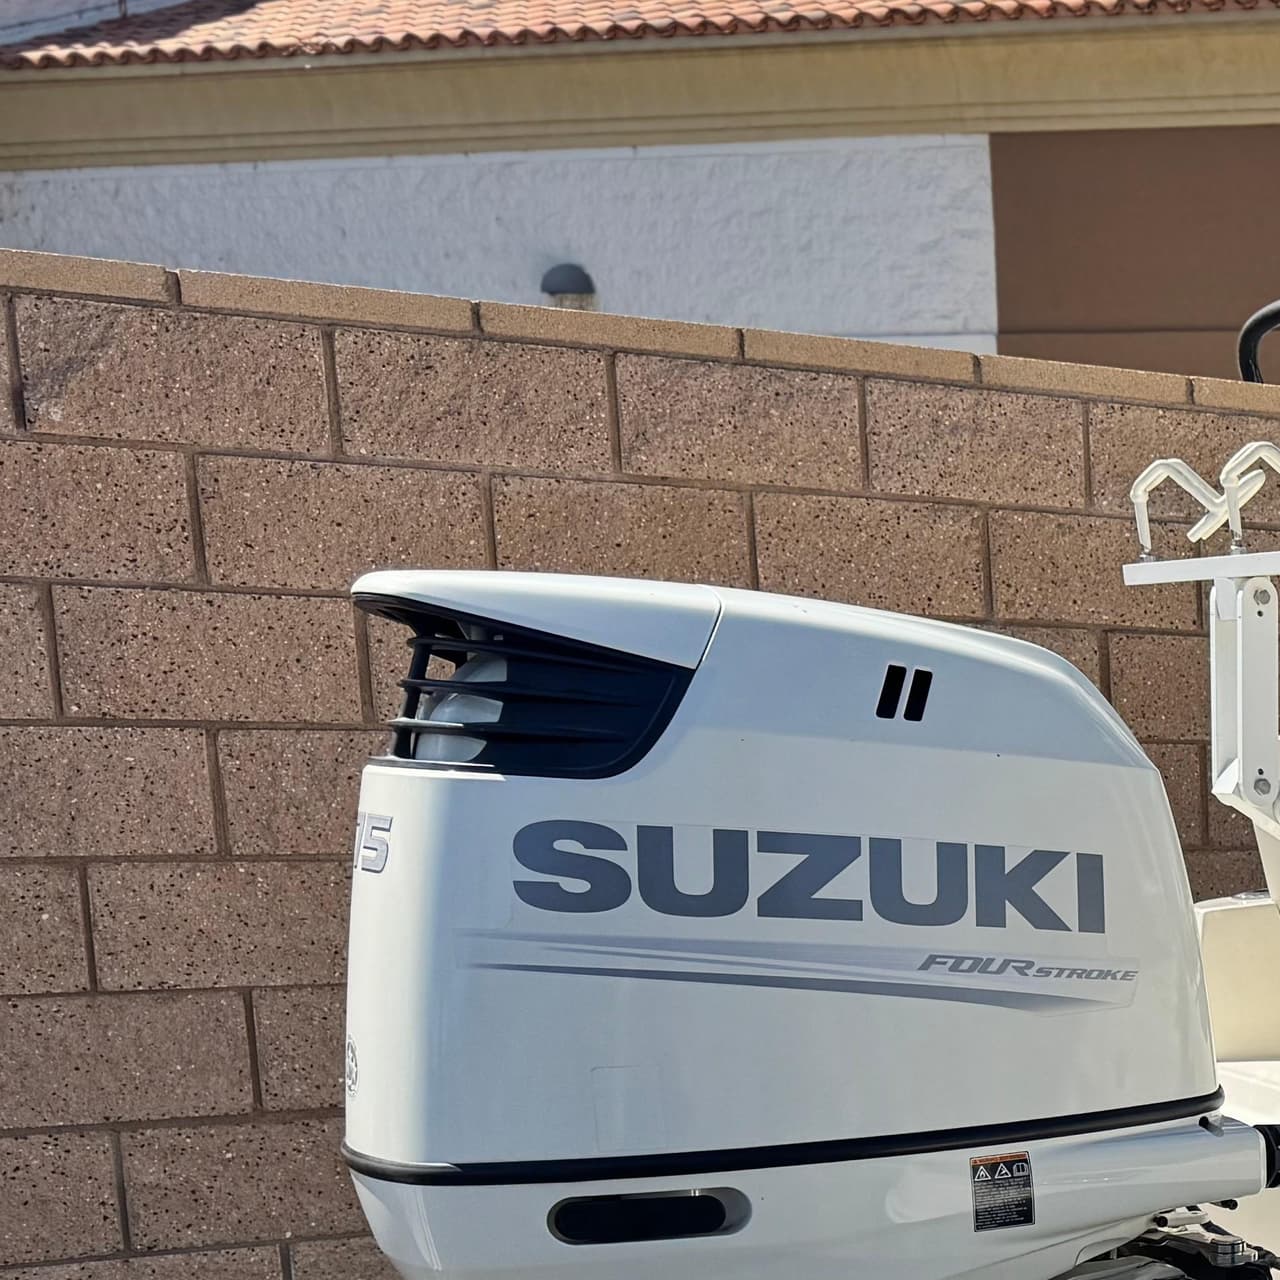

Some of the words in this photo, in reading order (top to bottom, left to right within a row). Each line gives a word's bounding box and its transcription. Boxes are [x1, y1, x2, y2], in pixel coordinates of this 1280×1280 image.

[512, 819, 1106, 935] SUZUKI
[917, 954, 1036, 978] FOUR
[1032, 967, 1139, 982] STROKE
